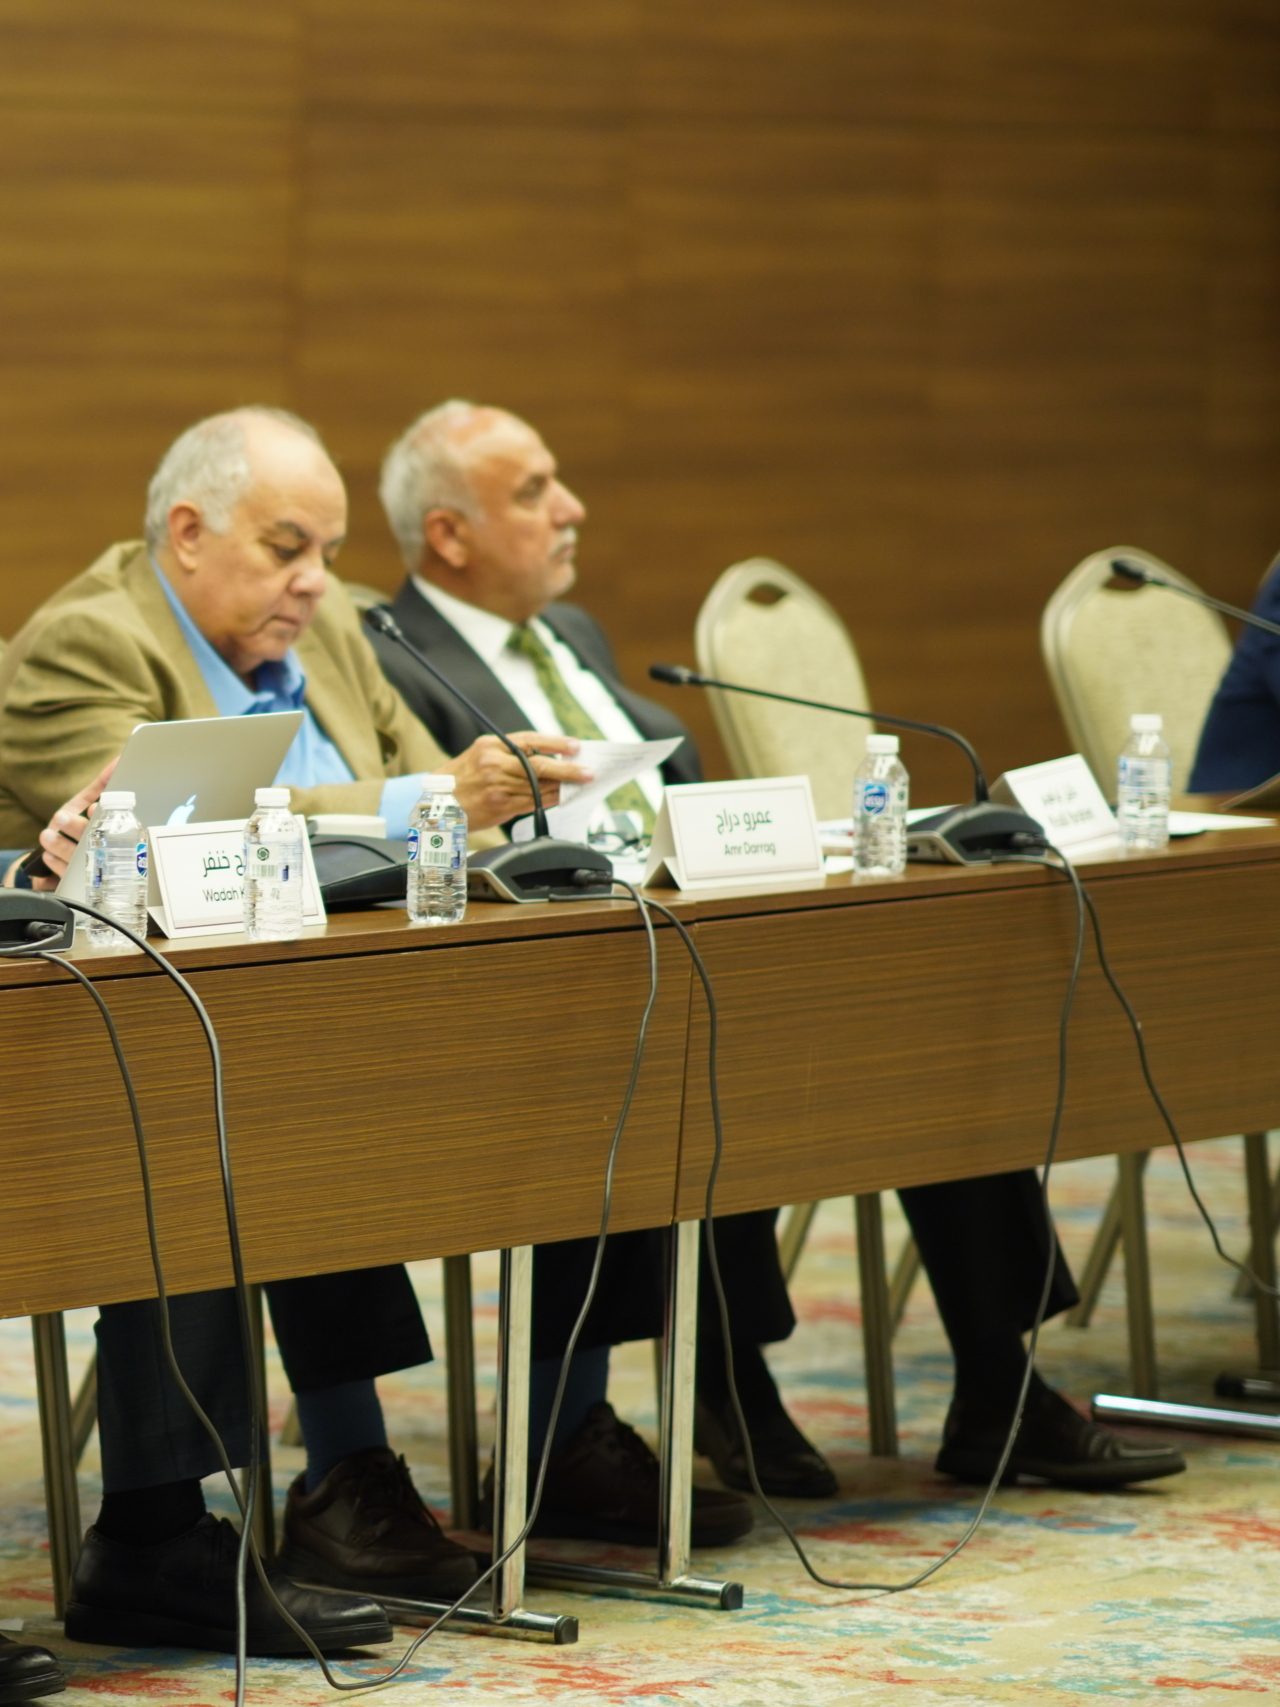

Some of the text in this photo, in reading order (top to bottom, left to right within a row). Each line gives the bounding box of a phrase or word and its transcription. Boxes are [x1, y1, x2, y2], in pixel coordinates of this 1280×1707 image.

[743, 810, 773, 831] عمرو
[724, 844, 742, 856] Amr
[202, 850, 231, 878] خنفر
[203, 887, 239, 902] Wadah
